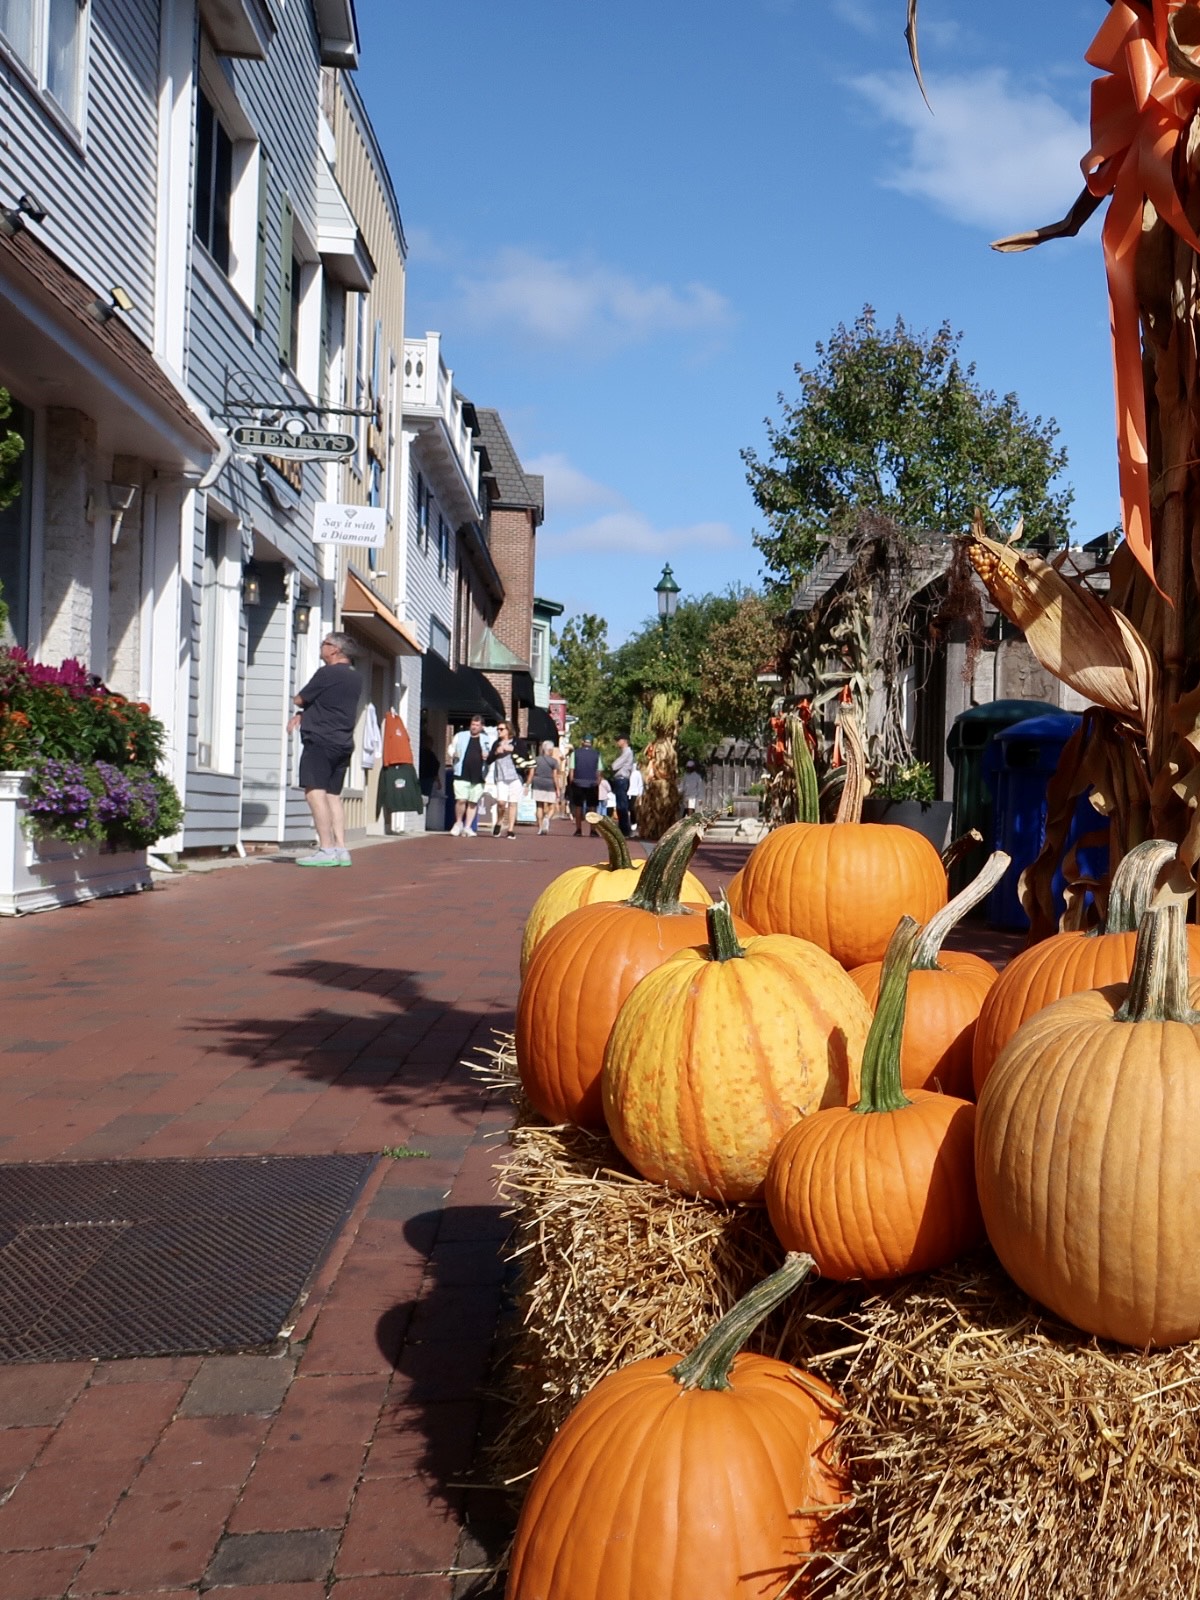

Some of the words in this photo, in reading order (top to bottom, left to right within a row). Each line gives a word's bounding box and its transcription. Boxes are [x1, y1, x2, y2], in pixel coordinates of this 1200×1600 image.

[241, 429, 348, 451] HENRY'S
[323, 517, 342, 529] Say
[344, 518, 354, 528] it
[354, 519, 376, 531] with
[330, 530, 378, 543] Diamond
